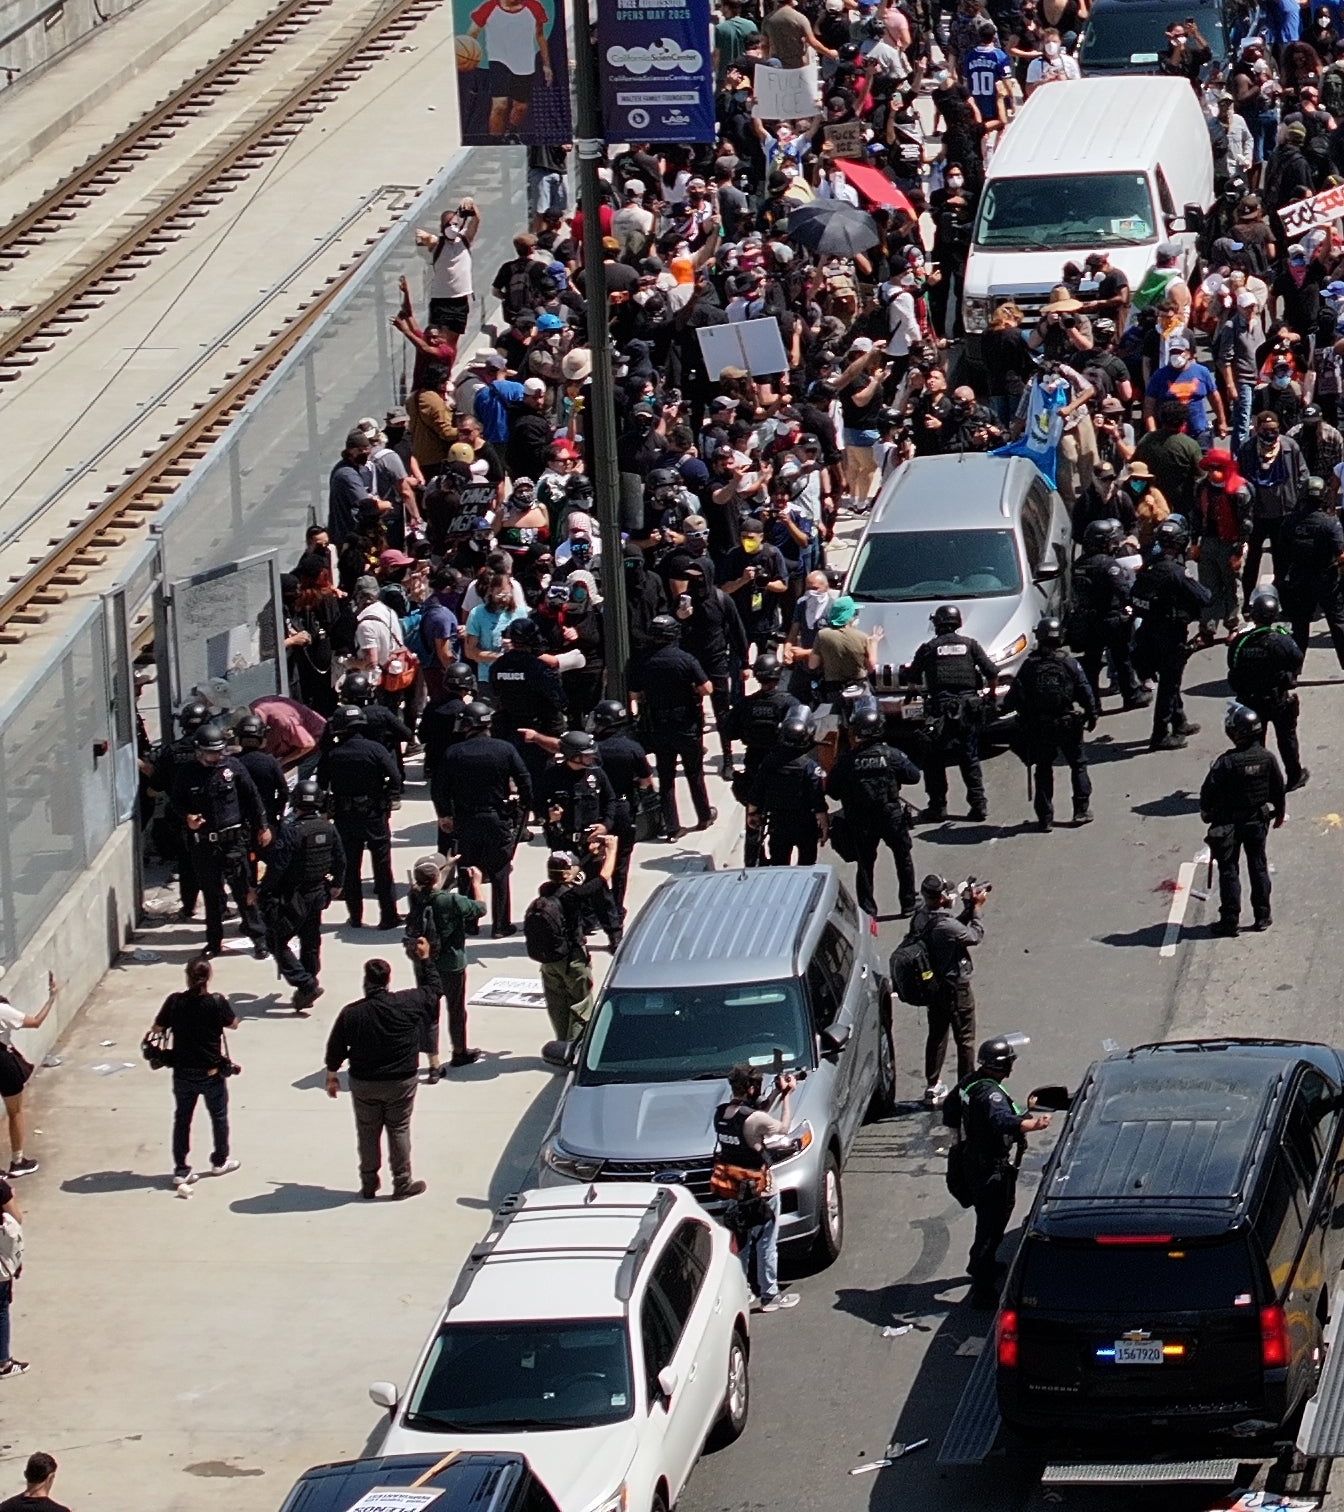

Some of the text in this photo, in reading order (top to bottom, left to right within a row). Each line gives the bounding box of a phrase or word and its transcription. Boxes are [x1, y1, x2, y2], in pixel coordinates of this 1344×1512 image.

[968, 58, 997, 70] AUGUST
[767, 72, 804, 90] FUCK
[971, 71, 994, 96] 10
[774, 92, 801, 114] ICE
[829, 130, 856, 141] FUCK
[836, 142, 853, 153] ICE
[1282, 201, 1322, 234] FUCK
[462, 505, 478, 515] LA
[497, 672, 525, 681] POLICE
[1117, 1349, 1160, 1361] 1567920
